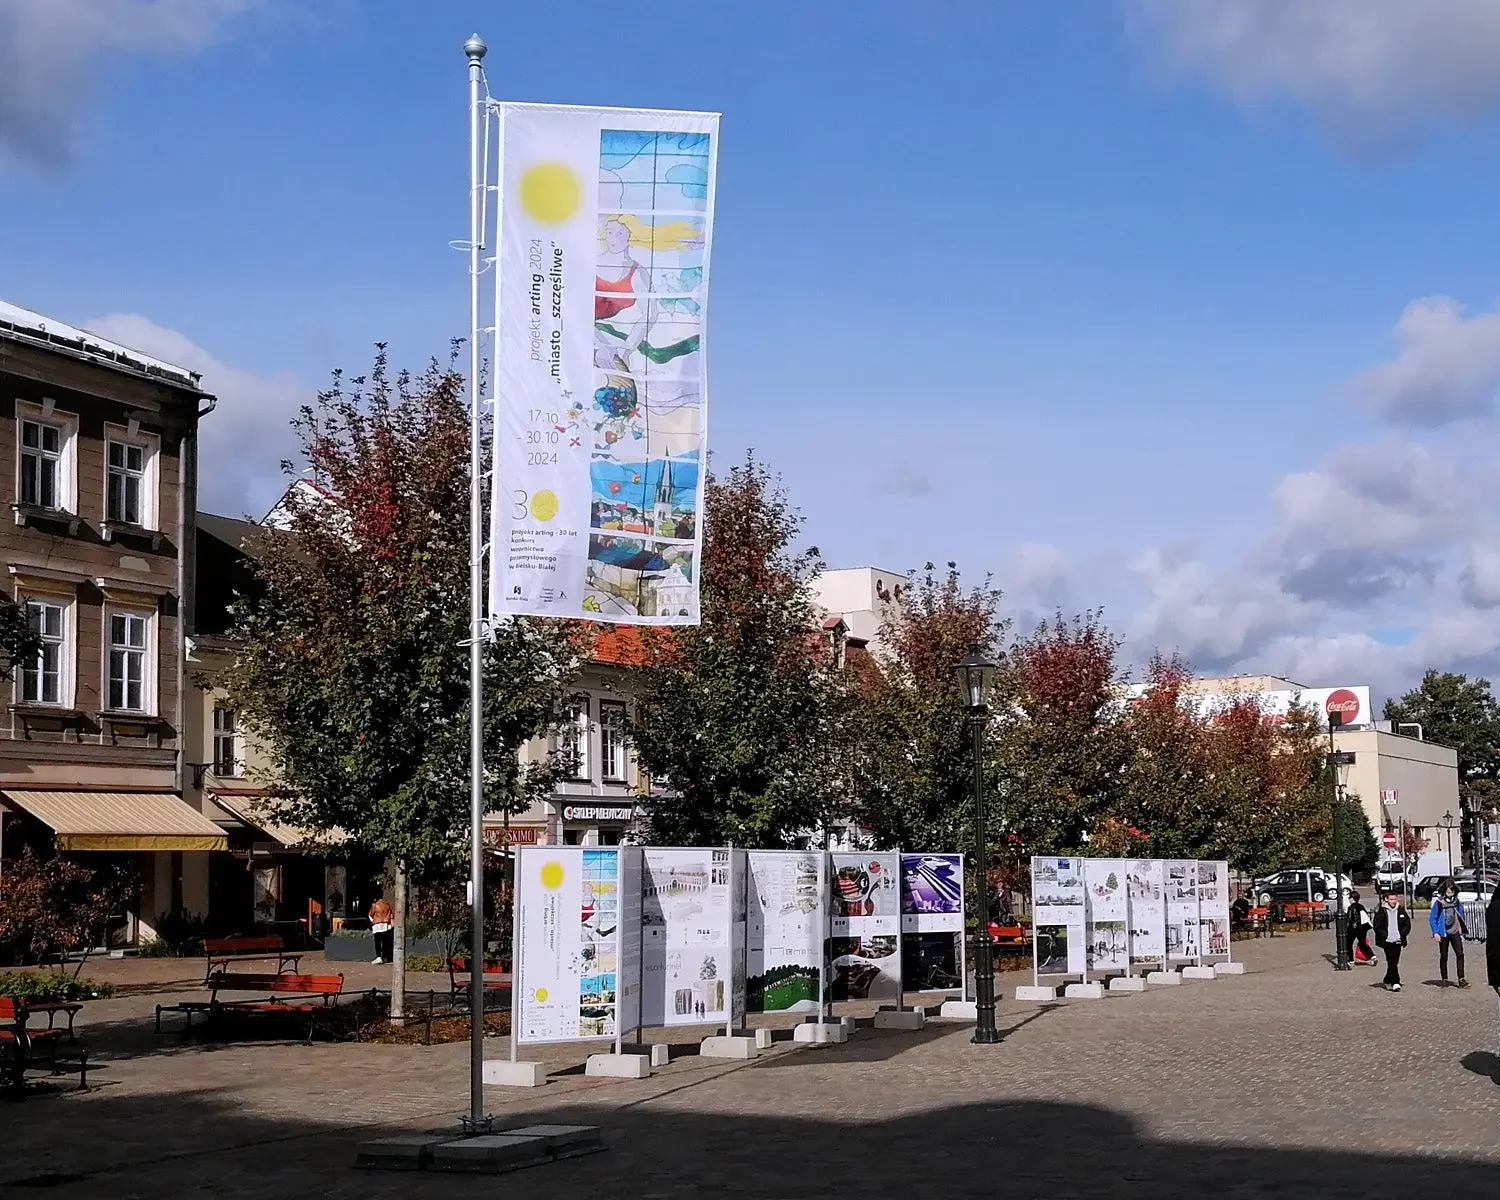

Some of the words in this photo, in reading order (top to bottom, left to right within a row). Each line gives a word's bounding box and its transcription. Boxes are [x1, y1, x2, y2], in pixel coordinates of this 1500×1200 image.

[529, 238, 543, 270] 2024
[528, 274, 545, 315] arting
[528, 319, 544, 361] projekt
[528, 409, 559, 424] 17.10
[526, 430, 559, 444] 30.10
[527, 452, 558, 466] 2024
